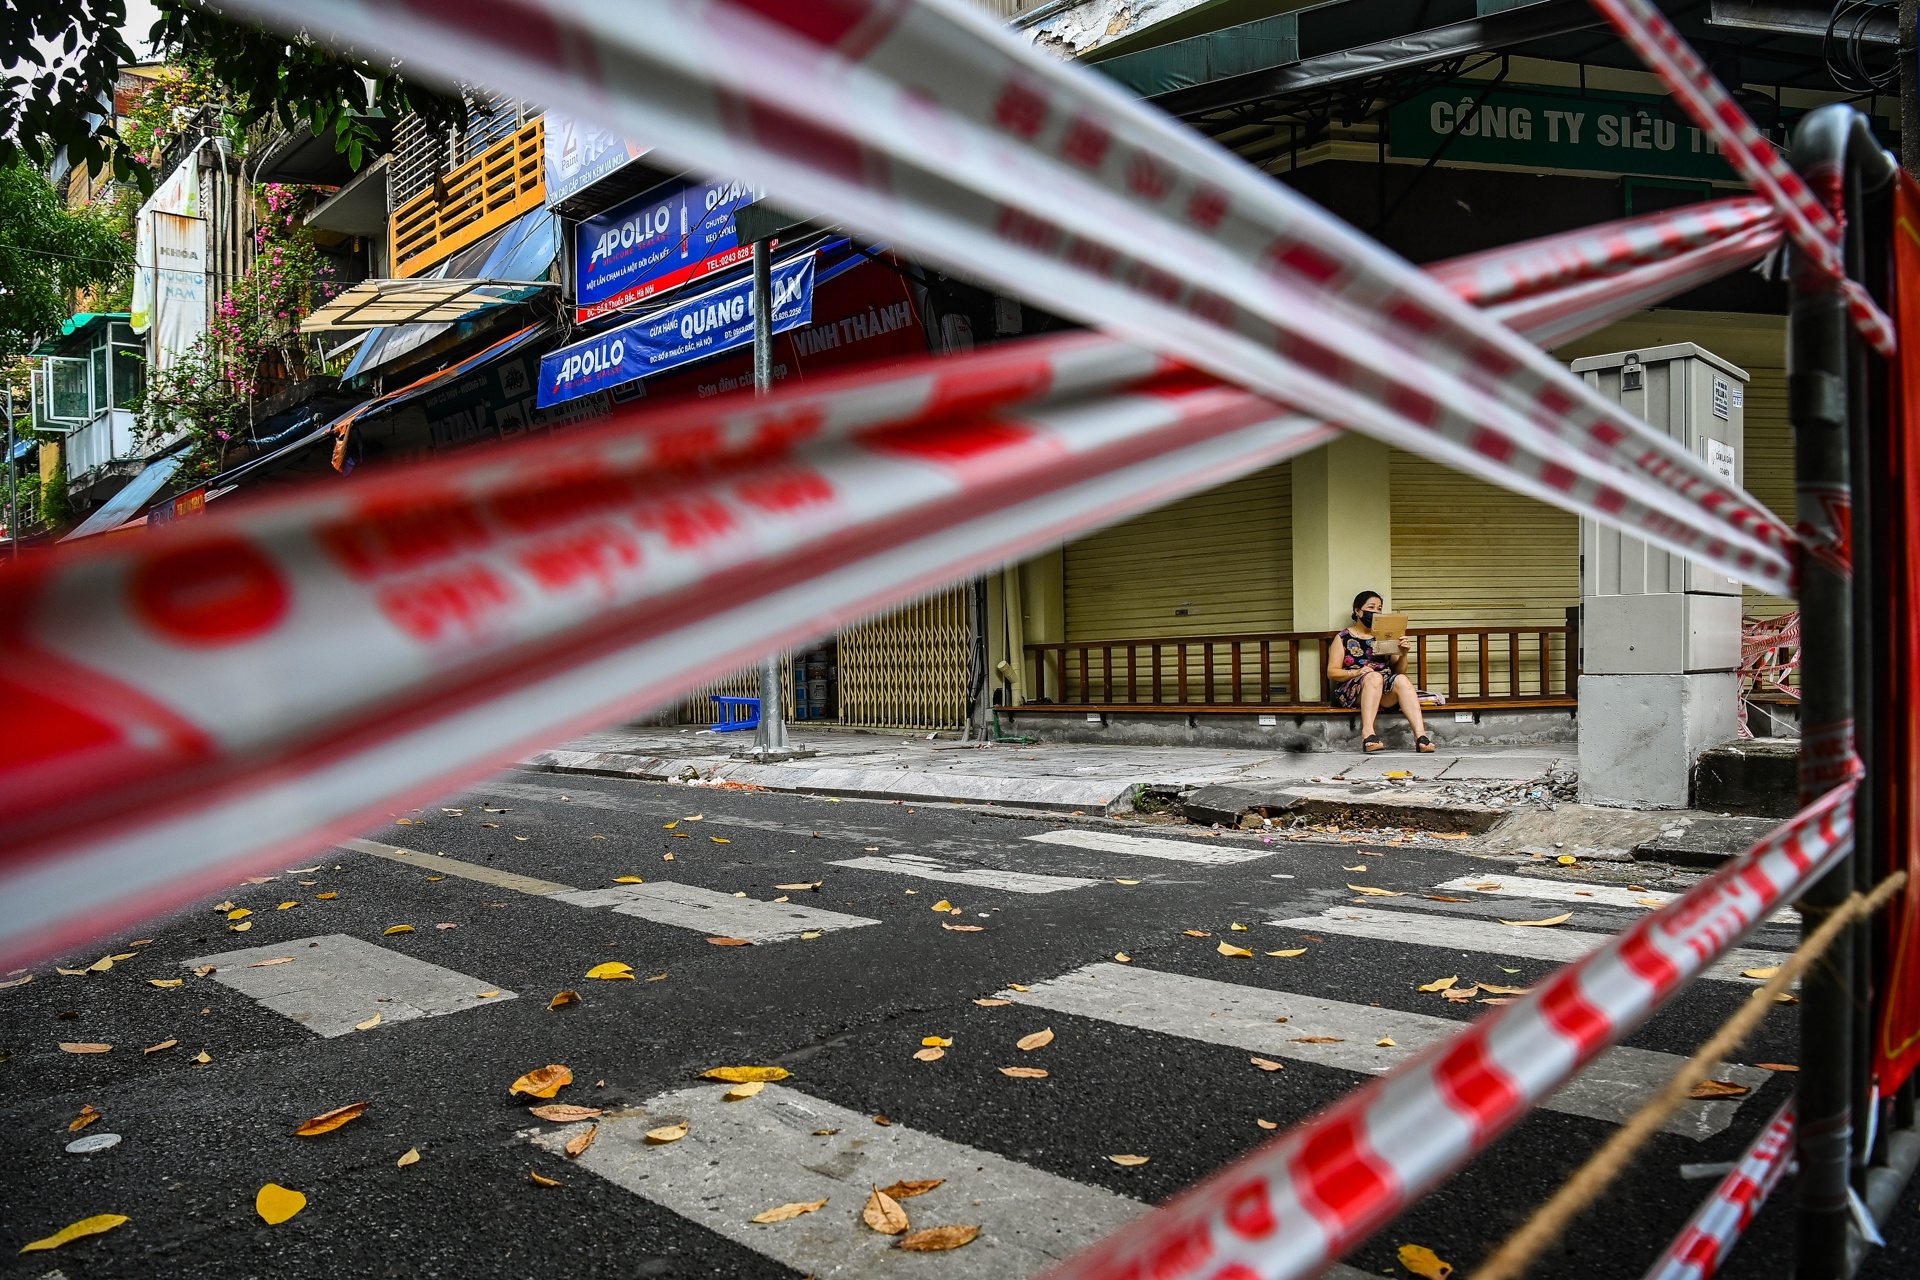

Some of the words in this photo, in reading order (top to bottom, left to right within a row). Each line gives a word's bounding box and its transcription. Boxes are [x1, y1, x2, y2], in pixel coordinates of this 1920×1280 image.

[1430, 97, 1532, 140] CÔNG
[1544, 111, 1585, 144] TY
[1597, 110, 1676, 151] SIÊU
[561, 154, 579, 171] Paint
[160, 247, 199, 261] KHÓA
[588, 205, 670, 272] APOLLO
[737, 246, 749, 260] 828
[165, 286, 196, 300] NAM
[681, 295, 744, 339] QUANG
[793, 325, 841, 357] VĨNH
[840, 300, 913, 343] THÀNH
[553, 339, 625, 394] APOLLO
